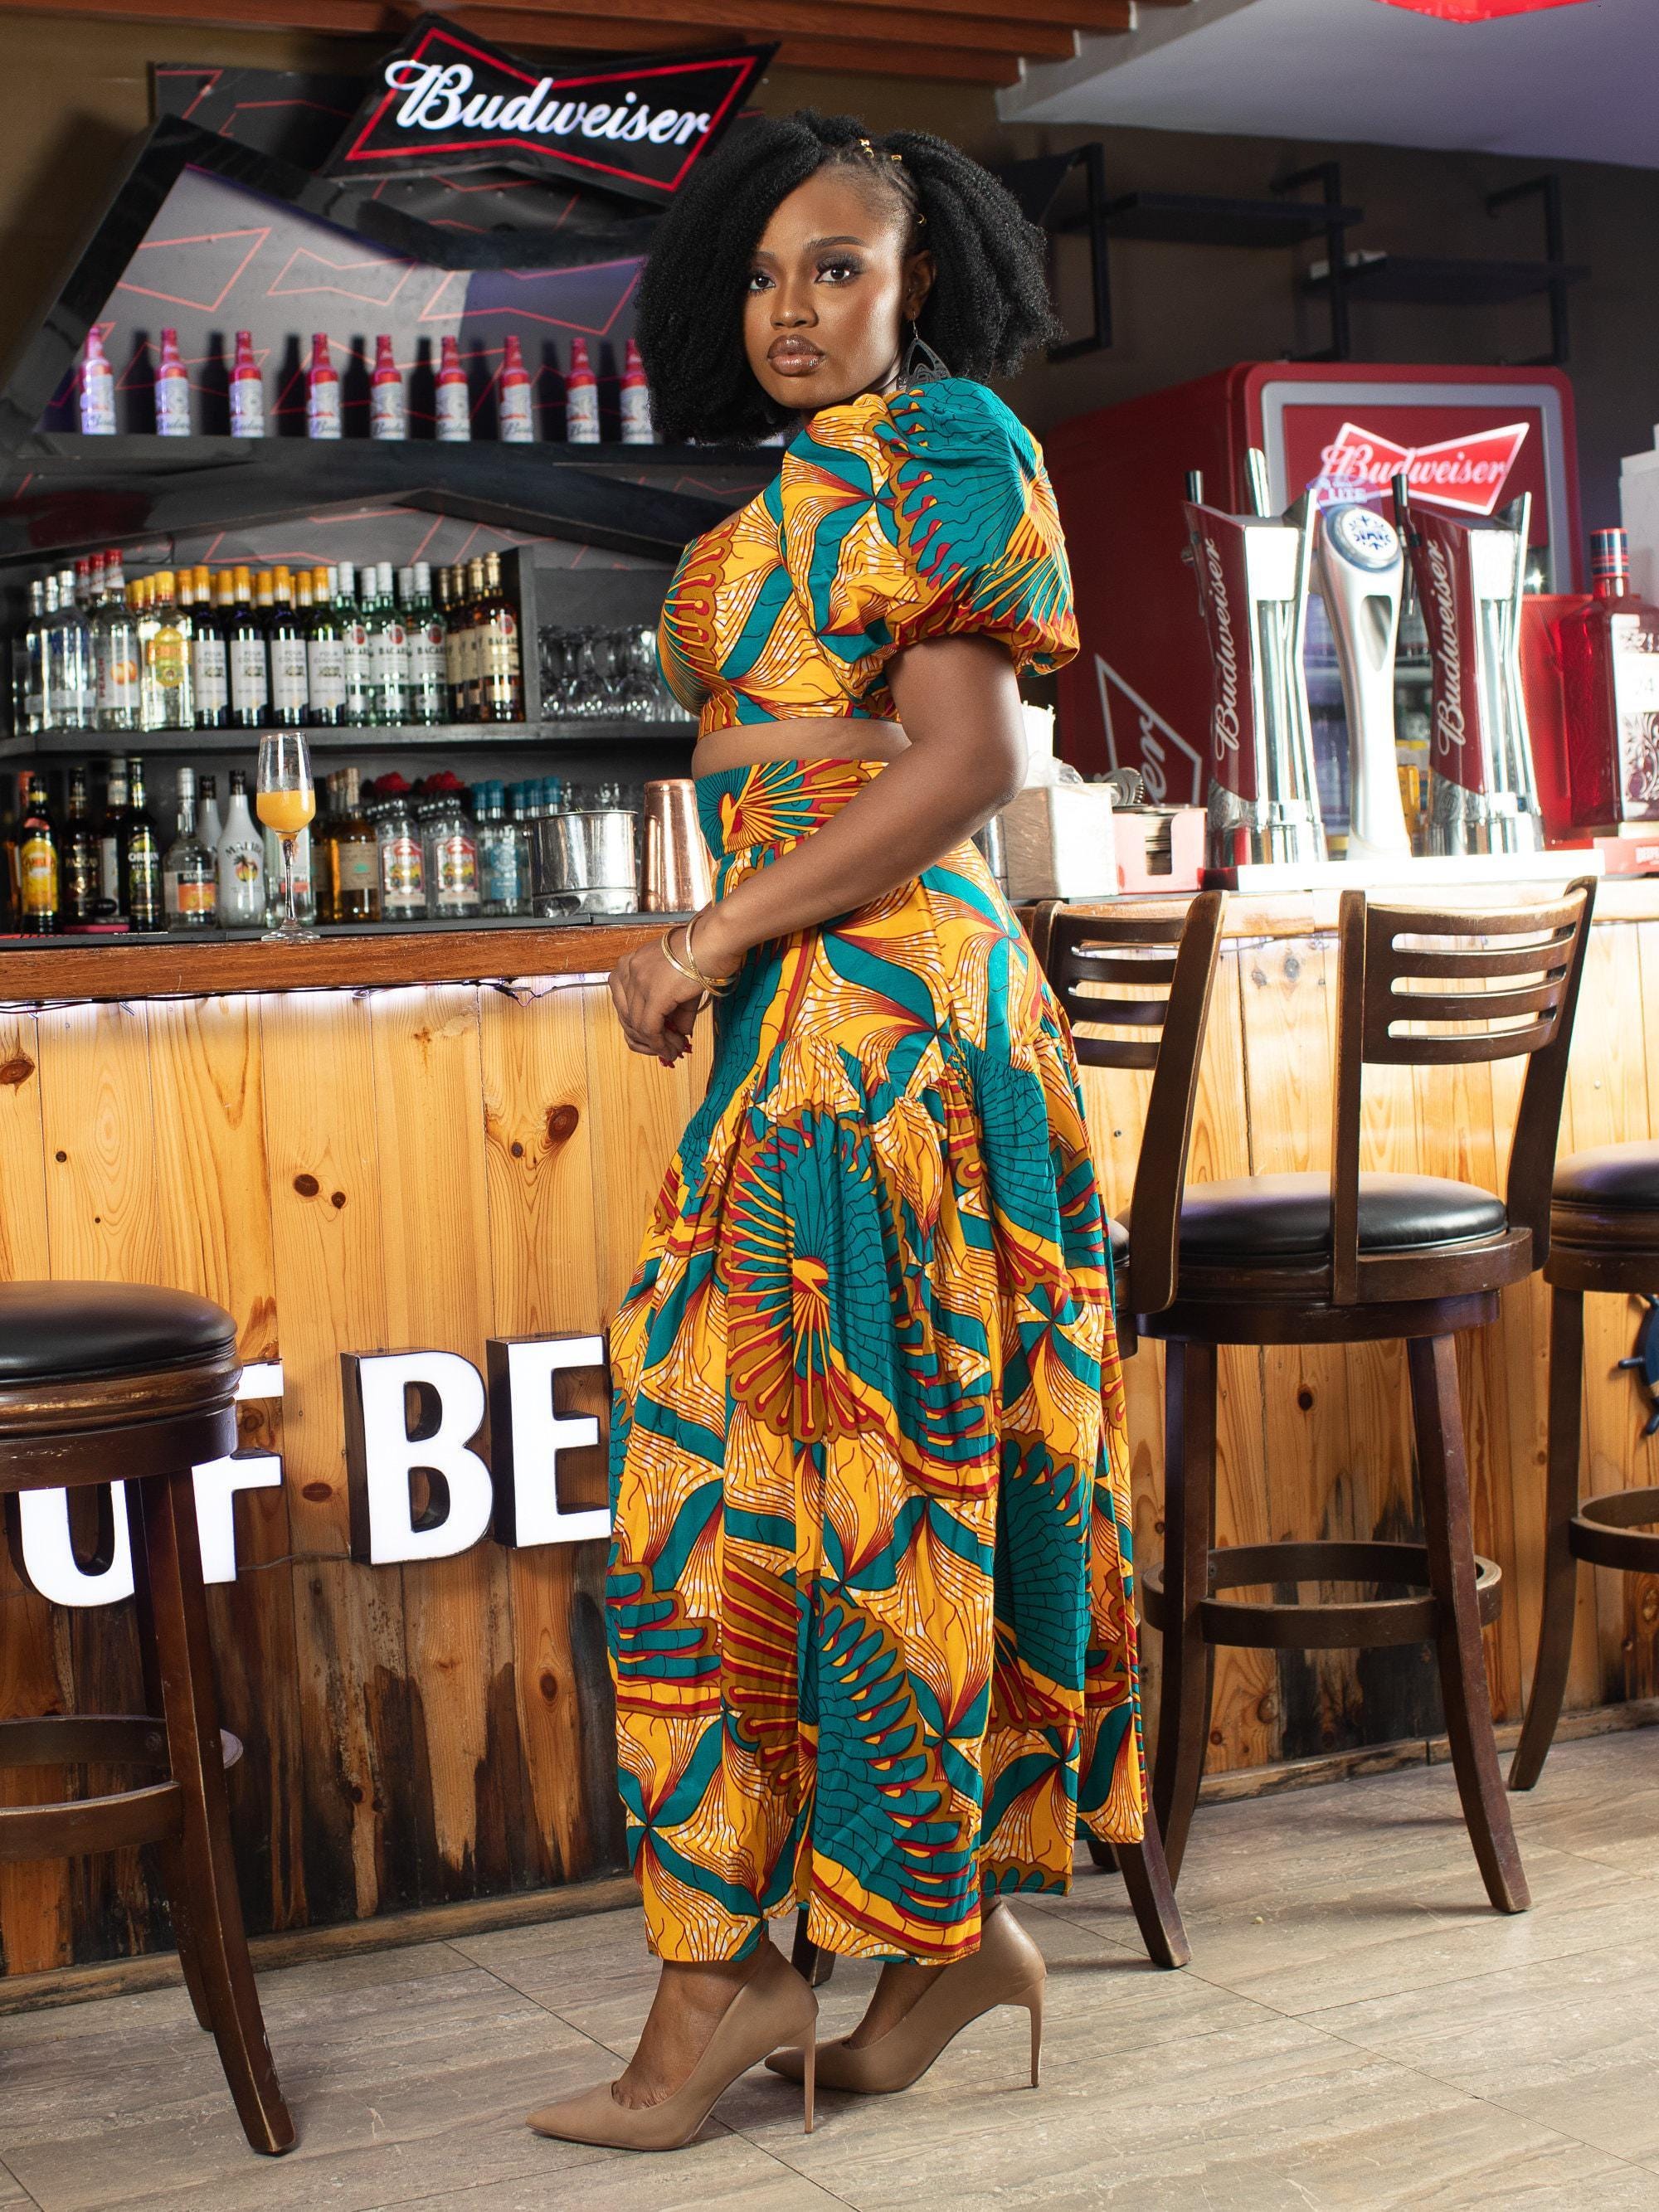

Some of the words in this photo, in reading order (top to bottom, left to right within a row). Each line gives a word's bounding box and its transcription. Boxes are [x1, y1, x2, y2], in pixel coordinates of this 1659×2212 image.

[383, 60, 712, 147] Budweiser
[1320, 443, 1509, 488] Budweiser
[1204, 537, 1240, 761] Budweiser
[1427, 538, 1466, 756] Budweiser
[359, 1335, 612, 1566] BE
